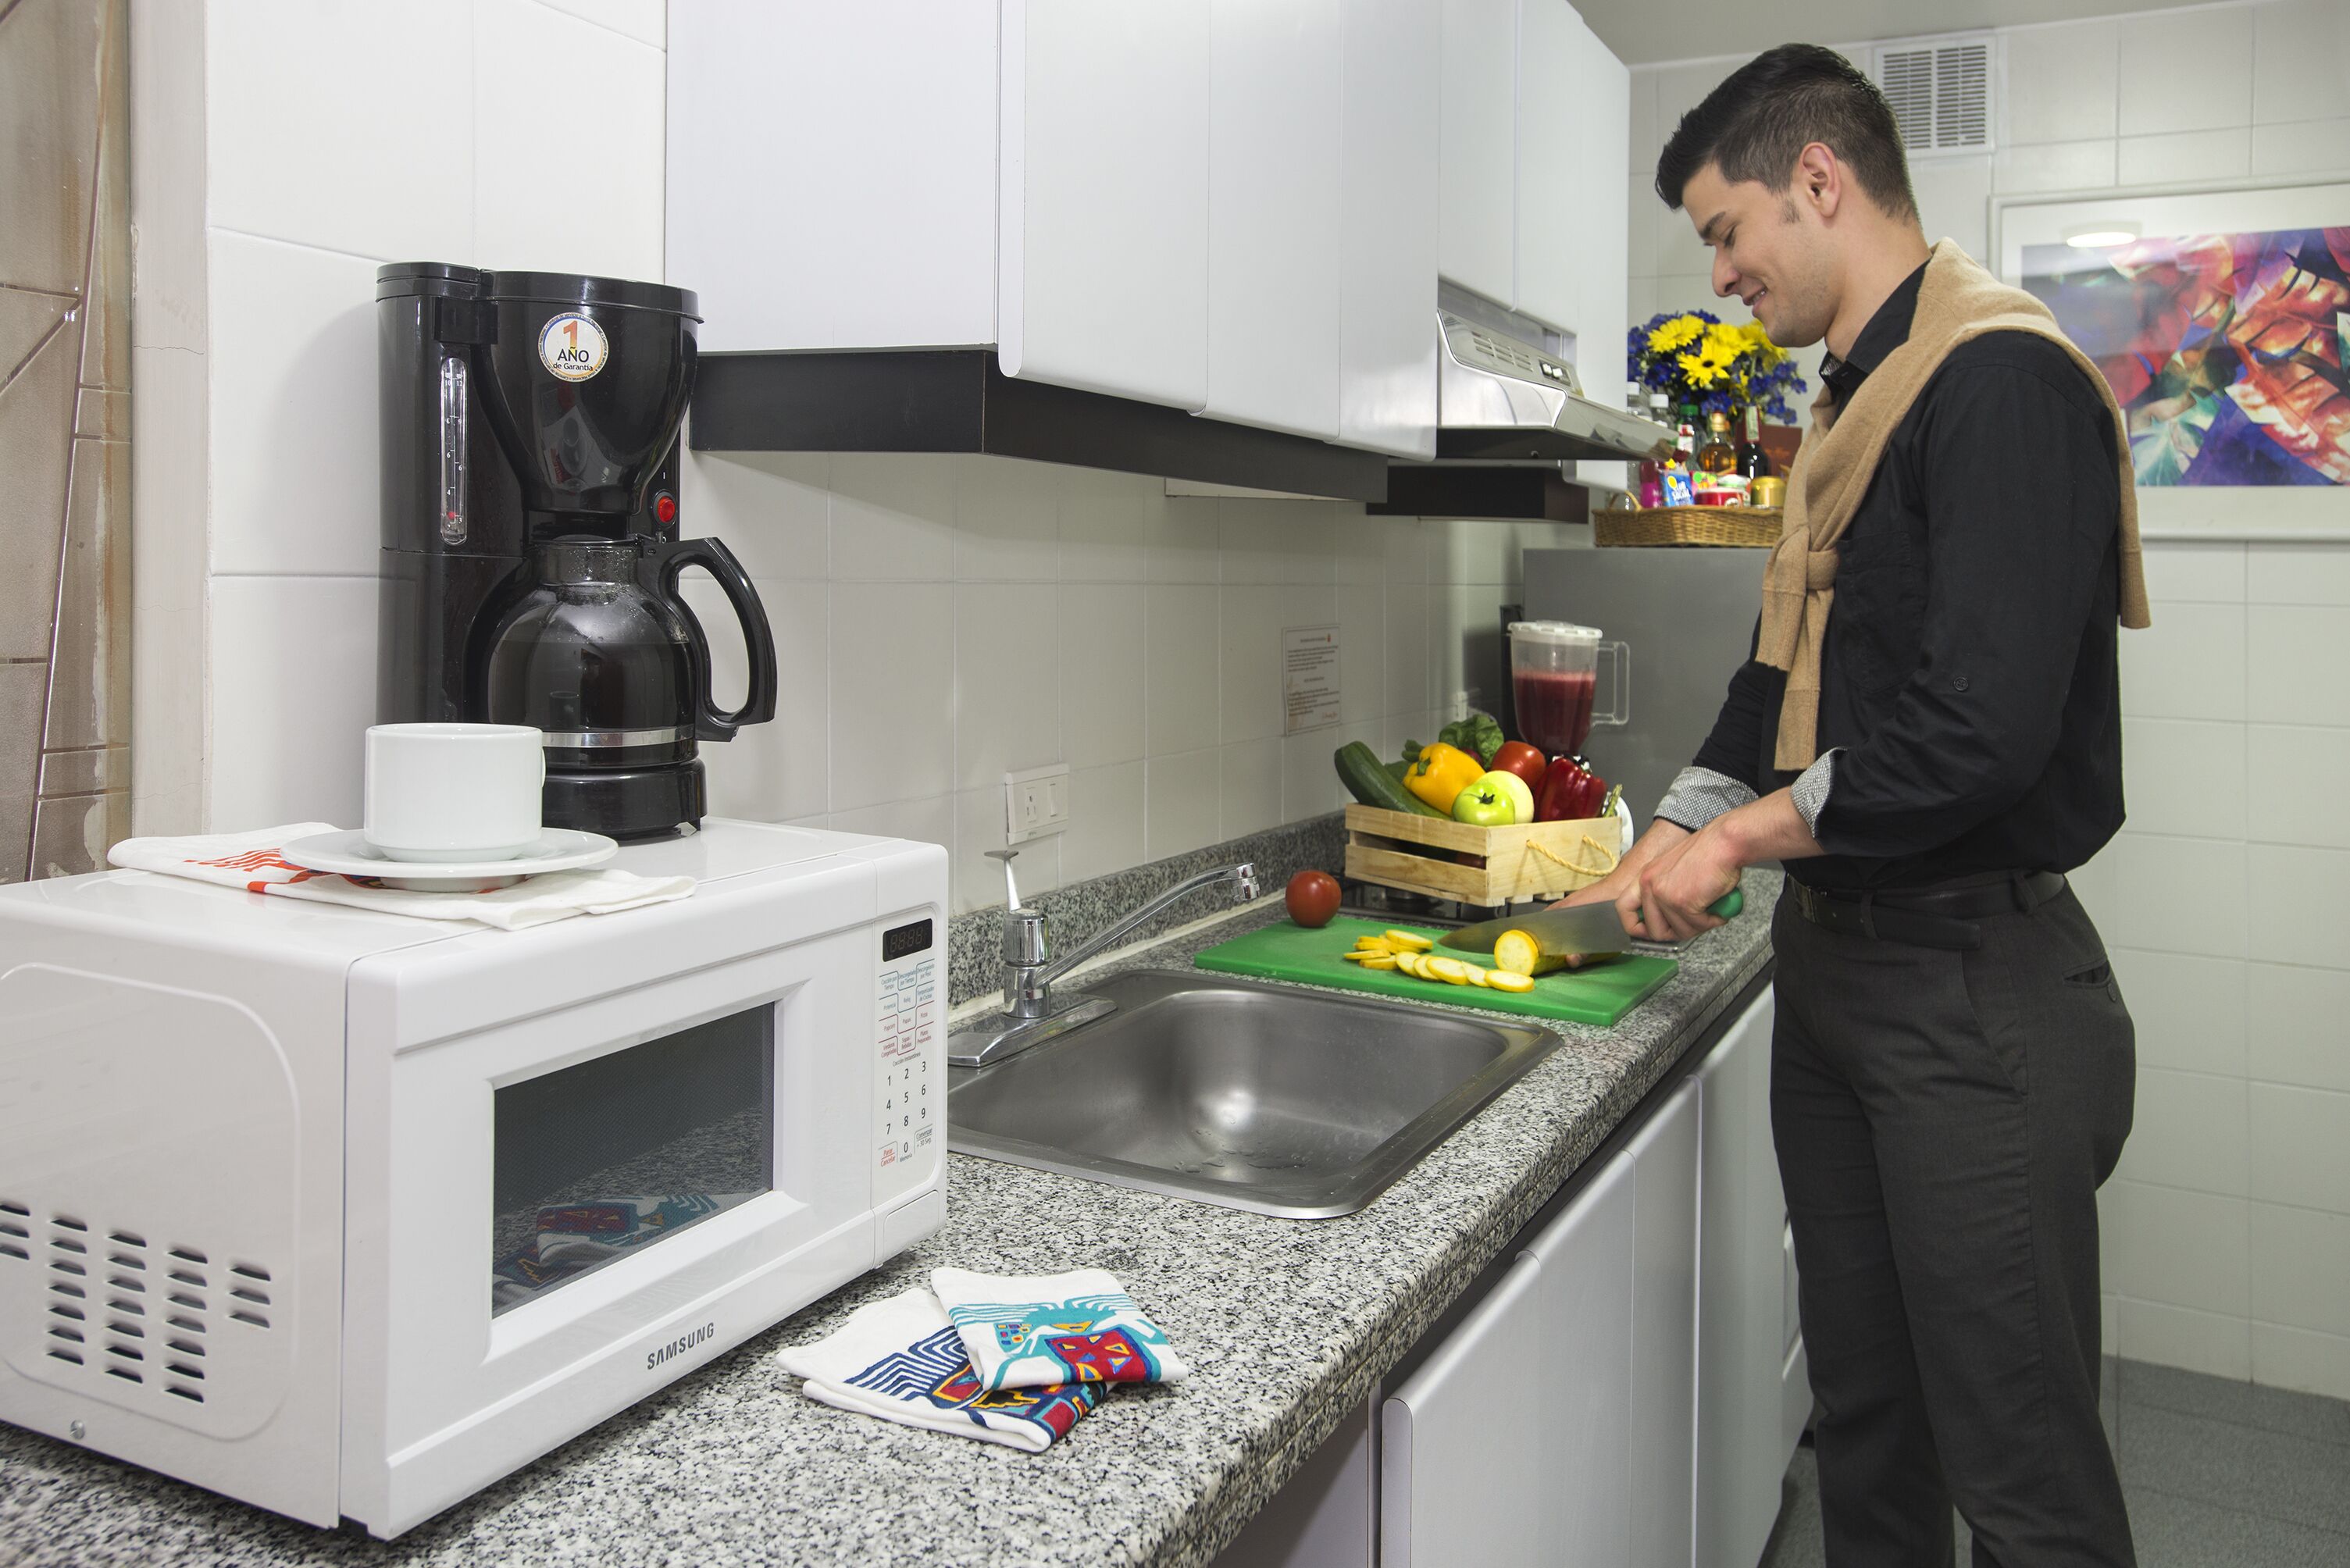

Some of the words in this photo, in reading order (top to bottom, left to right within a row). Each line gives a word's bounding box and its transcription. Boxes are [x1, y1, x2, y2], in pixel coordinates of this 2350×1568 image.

[563, 320, 578, 351] 1
[558, 347, 590, 363] AÑO
[922, 1060, 926, 1072] 3
[904, 1067, 909, 1079] 2
[887, 1074, 891, 1086] 1
[922, 1084, 925, 1096] 6
[904, 1092, 909, 1103] 5
[886, 1099, 891, 1110] 4
[922, 1107, 925, 1119] 9
[904, 1115, 908, 1127] 8
[886, 1123, 891, 1135] 7
[904, 1142, 908, 1153] 0
[647, 1322, 714, 1370] SAMSUNG
